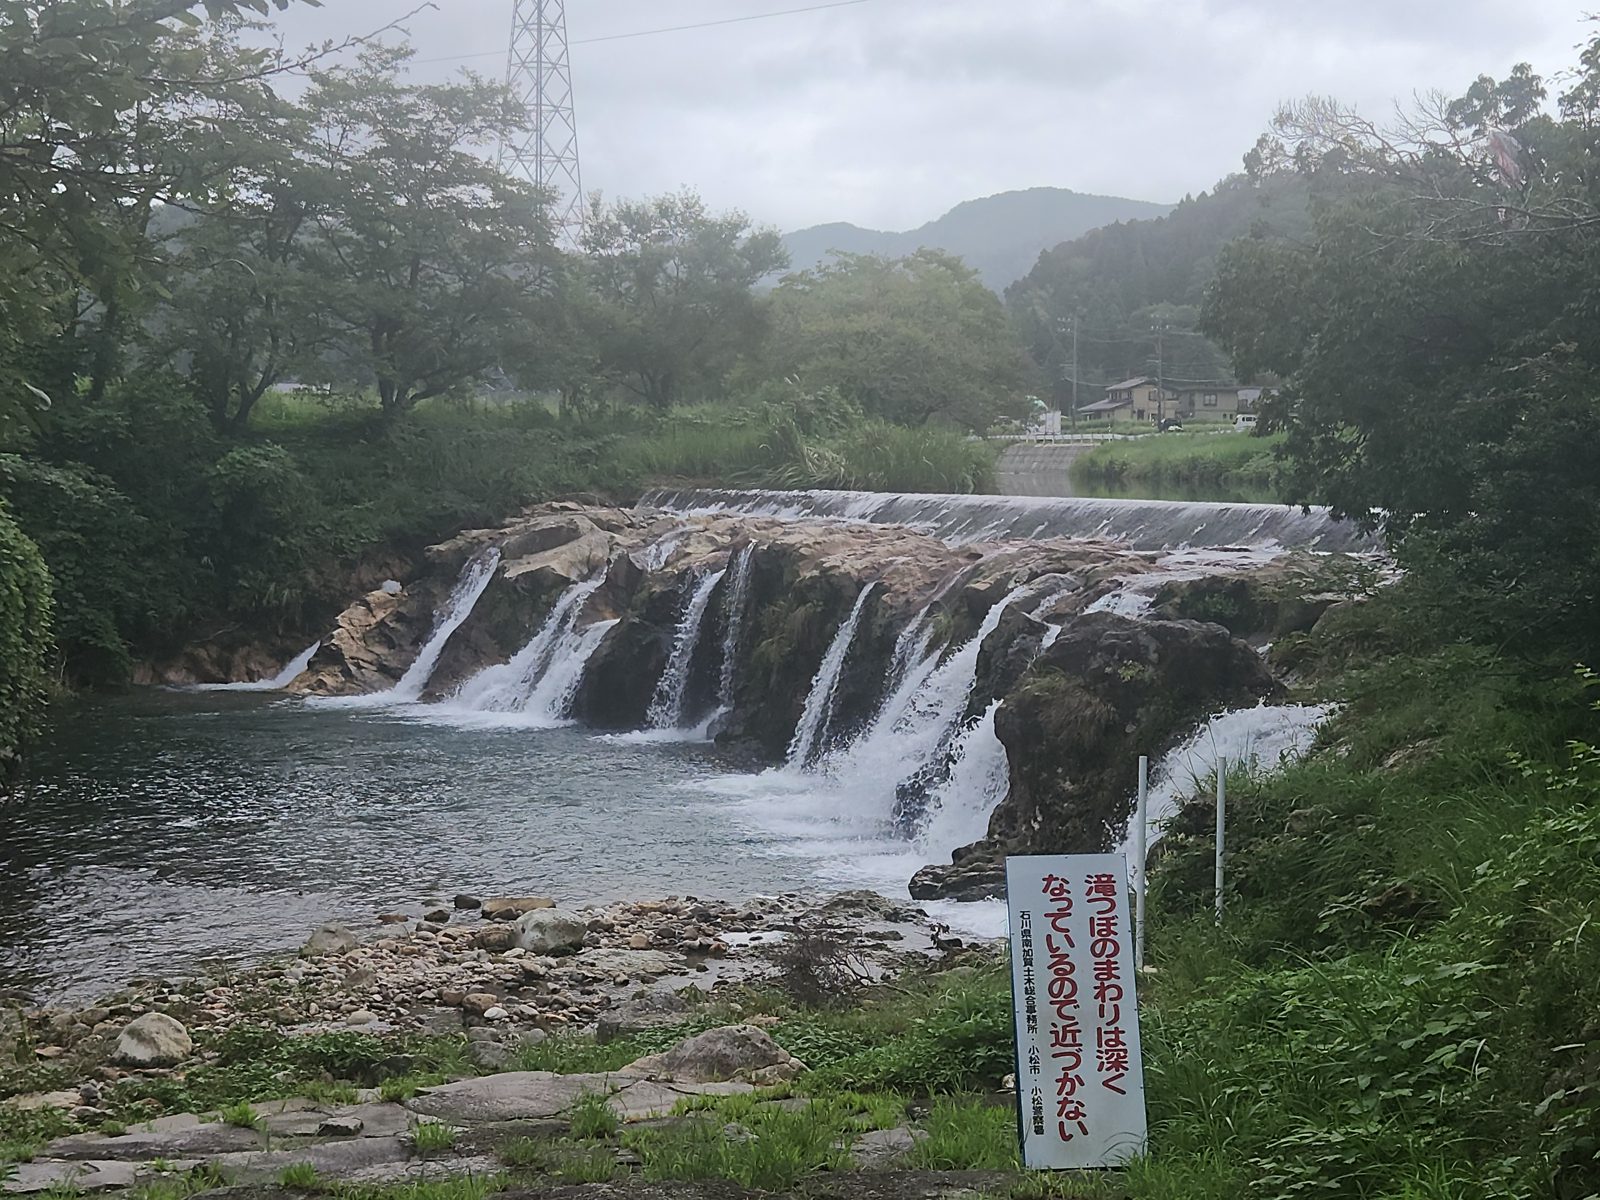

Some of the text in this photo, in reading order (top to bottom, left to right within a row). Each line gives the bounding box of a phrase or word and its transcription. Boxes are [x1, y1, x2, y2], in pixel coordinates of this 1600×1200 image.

[1041, 873, 1089, 1142] なっているので近づかない
[1084, 873, 1130, 1096] 滝つぼのまわりは深く
